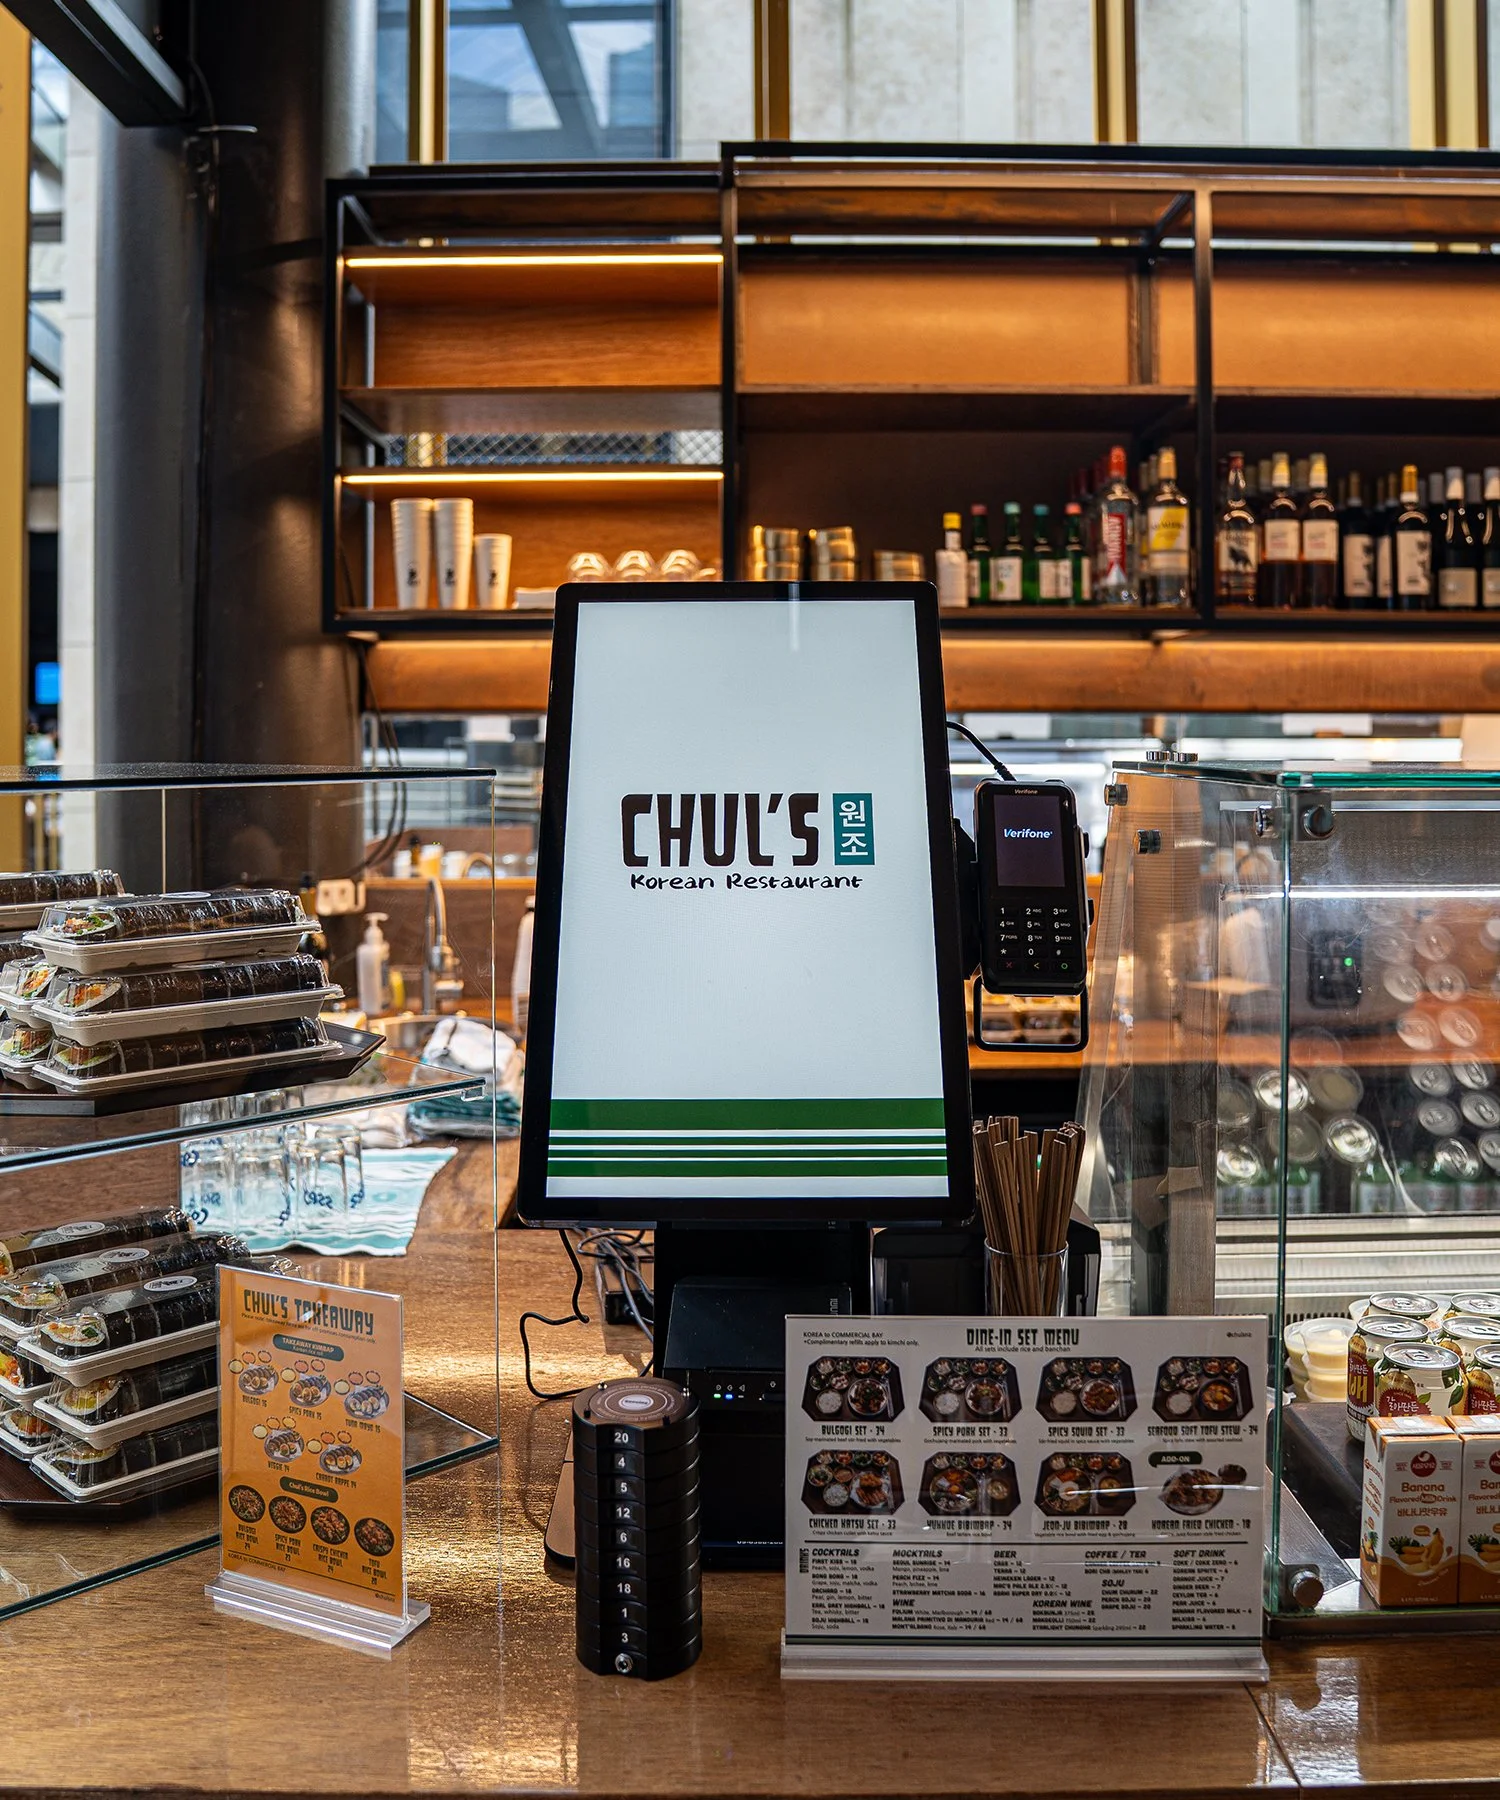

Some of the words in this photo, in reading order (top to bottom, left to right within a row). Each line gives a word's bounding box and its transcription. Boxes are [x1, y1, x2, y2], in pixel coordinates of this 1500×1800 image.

[621, 793, 819, 867] CHUL'S
[839, 800, 869, 857] 원조
[1004, 828, 1052, 839] Verifone
[630, 872, 715, 889] Korean
[726, 872, 863, 889] Restaurant
[1026, 907, 1032, 915] 2
[1053, 907, 1059, 915] 3
[243, 1289, 288, 1319] CHUL'S
[294, 1298, 374, 1335] TAKEAWAY
[966, 1328, 1012, 1345] DINE-IN
[1017, 1328, 1038, 1345] SET
[1043, 1328, 1079, 1345] MENU
[289, 1406, 301, 1416] SPICY
[303, 1409, 315, 1419] PORK
[821, 1425, 852, 1435] BULGOGI
[855, 1425, 867, 1435] SET
[933, 1426, 954, 1436] SPICY
[956, 1426, 976, 1436] PORK
[978, 1426, 991, 1436] SET
[999, 1426, 1008, 1436] 33
[1048, 1426, 1069, 1436] SPICY
[1071, 1426, 1093, 1436] SQUID
[1095, 1426, 1108, 1436] SET
[1116, 1426, 1125, 1436] 33
[1147, 1425, 1178, 1436] SEAFOOD
[1181, 1425, 1198, 1436] SOFT
[1200, 1425, 1218, 1436] TOFU
[1221, 1425, 1241, 1436] STEW
[614, 1432, 628, 1443] 20
[618, 1457, 626, 1467] 4
[1161, 1455, 1190, 1463] ADD-ON
[316, 1487, 329, 1497] Bowl
[620, 1482, 627, 1492] 5
[1401, 1482, 1445, 1492] Banana
[1389, 1496, 1421, 1504] Flavored
[616, 1507, 630, 1518] 12
[1397, 1507, 1448, 1517] 바나나맛우유
[809, 1518, 838, 1529] CHICKEN
[841, 1518, 865, 1529] KATSU
[867, 1518, 879, 1529] SET
[888, 1518, 897, 1529] 33
[957, 1520, 994, 1530] BIBIMBAP
[1074, 1520, 1110, 1530] BIBIMBAP
[1151, 1519, 1180, 1530] KOREAN
[1182, 1519, 1202, 1530] FRIED
[1204, 1519, 1234, 1530] CHICKEN
[620, 1532, 627, 1543] 6
[812, 1549, 859, 1557] COCKTAILS
[893, 1550, 942, 1558] MOCKTAILS
[616, 1557, 630, 1568] 16
[1101, 1579, 1125, 1587] SOJU
[617, 1583, 631, 1594] 18
[621, 1608, 627, 1618] 1
[621, 1632, 628, 1643] 3
